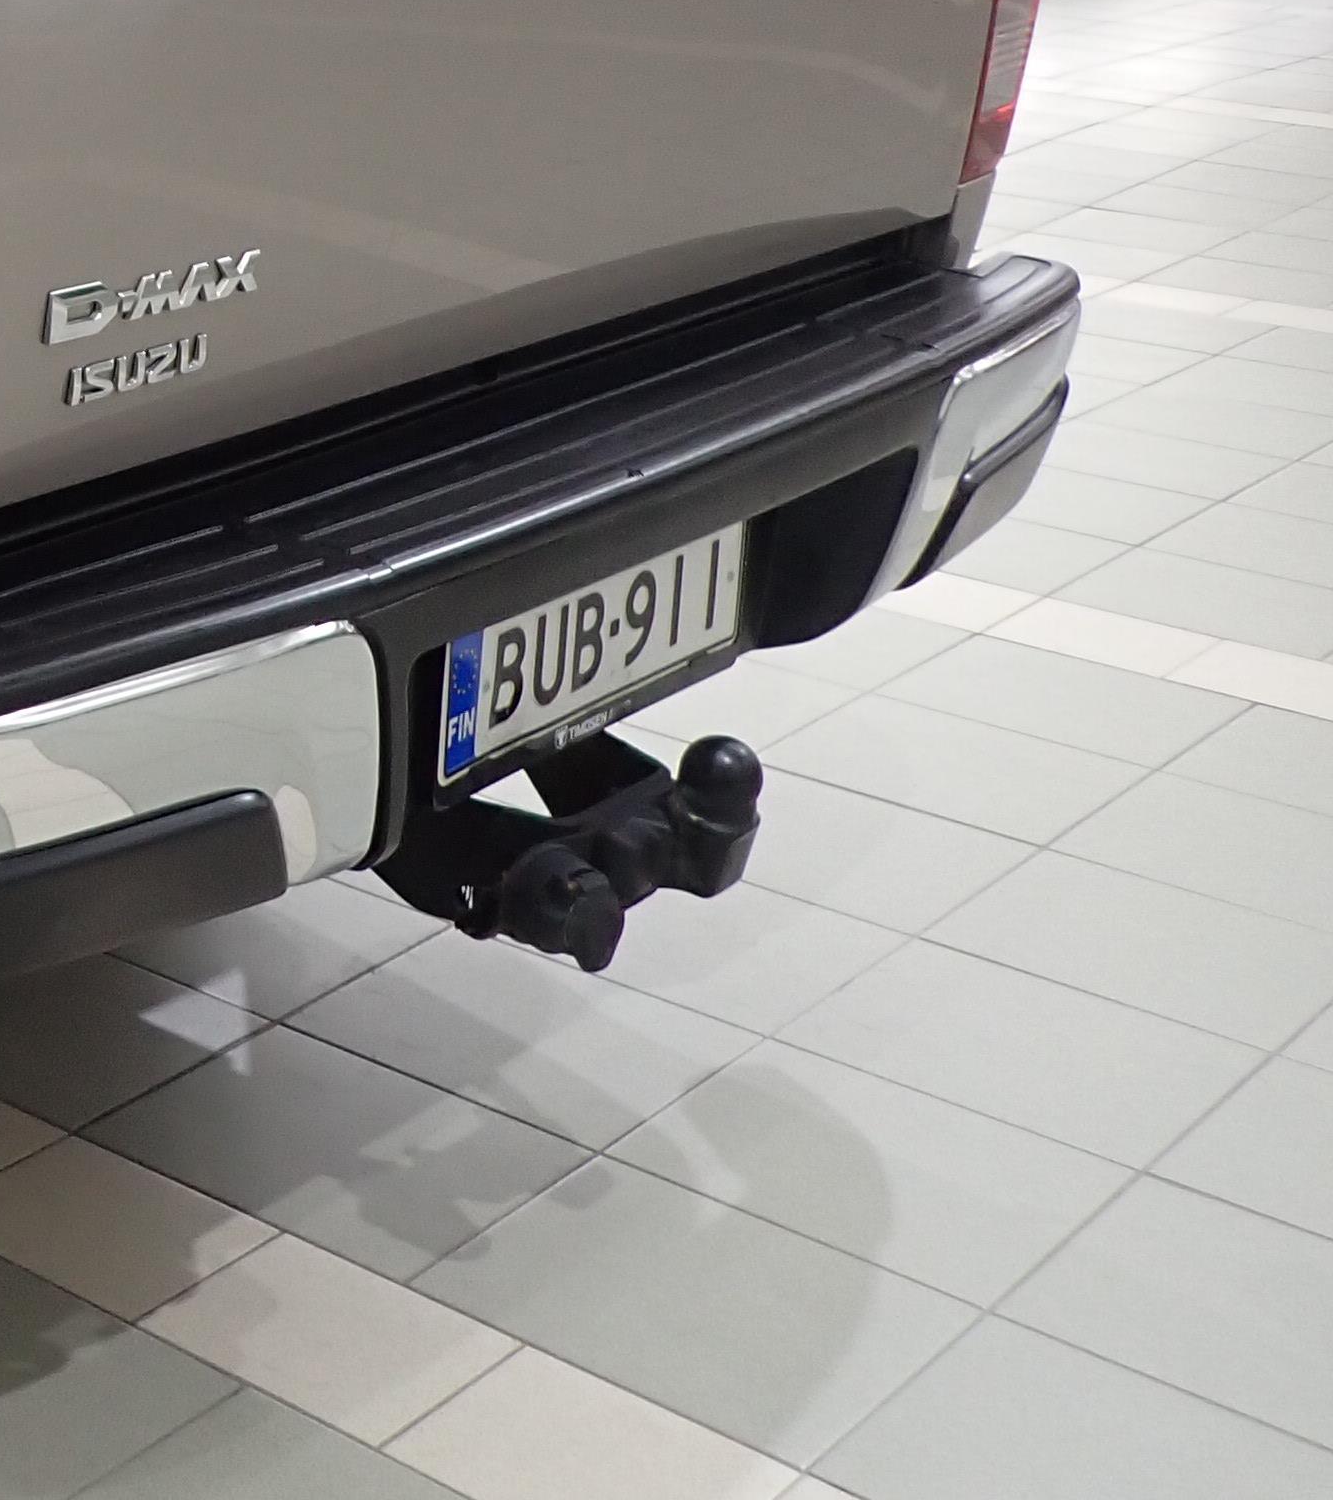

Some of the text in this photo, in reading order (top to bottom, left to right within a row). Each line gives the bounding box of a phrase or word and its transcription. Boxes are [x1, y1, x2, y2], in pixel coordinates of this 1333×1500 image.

[65, 333, 207, 406] ISUZU
[490, 538, 720, 728] BUB-911
[447, 707, 477, 748] FIN
